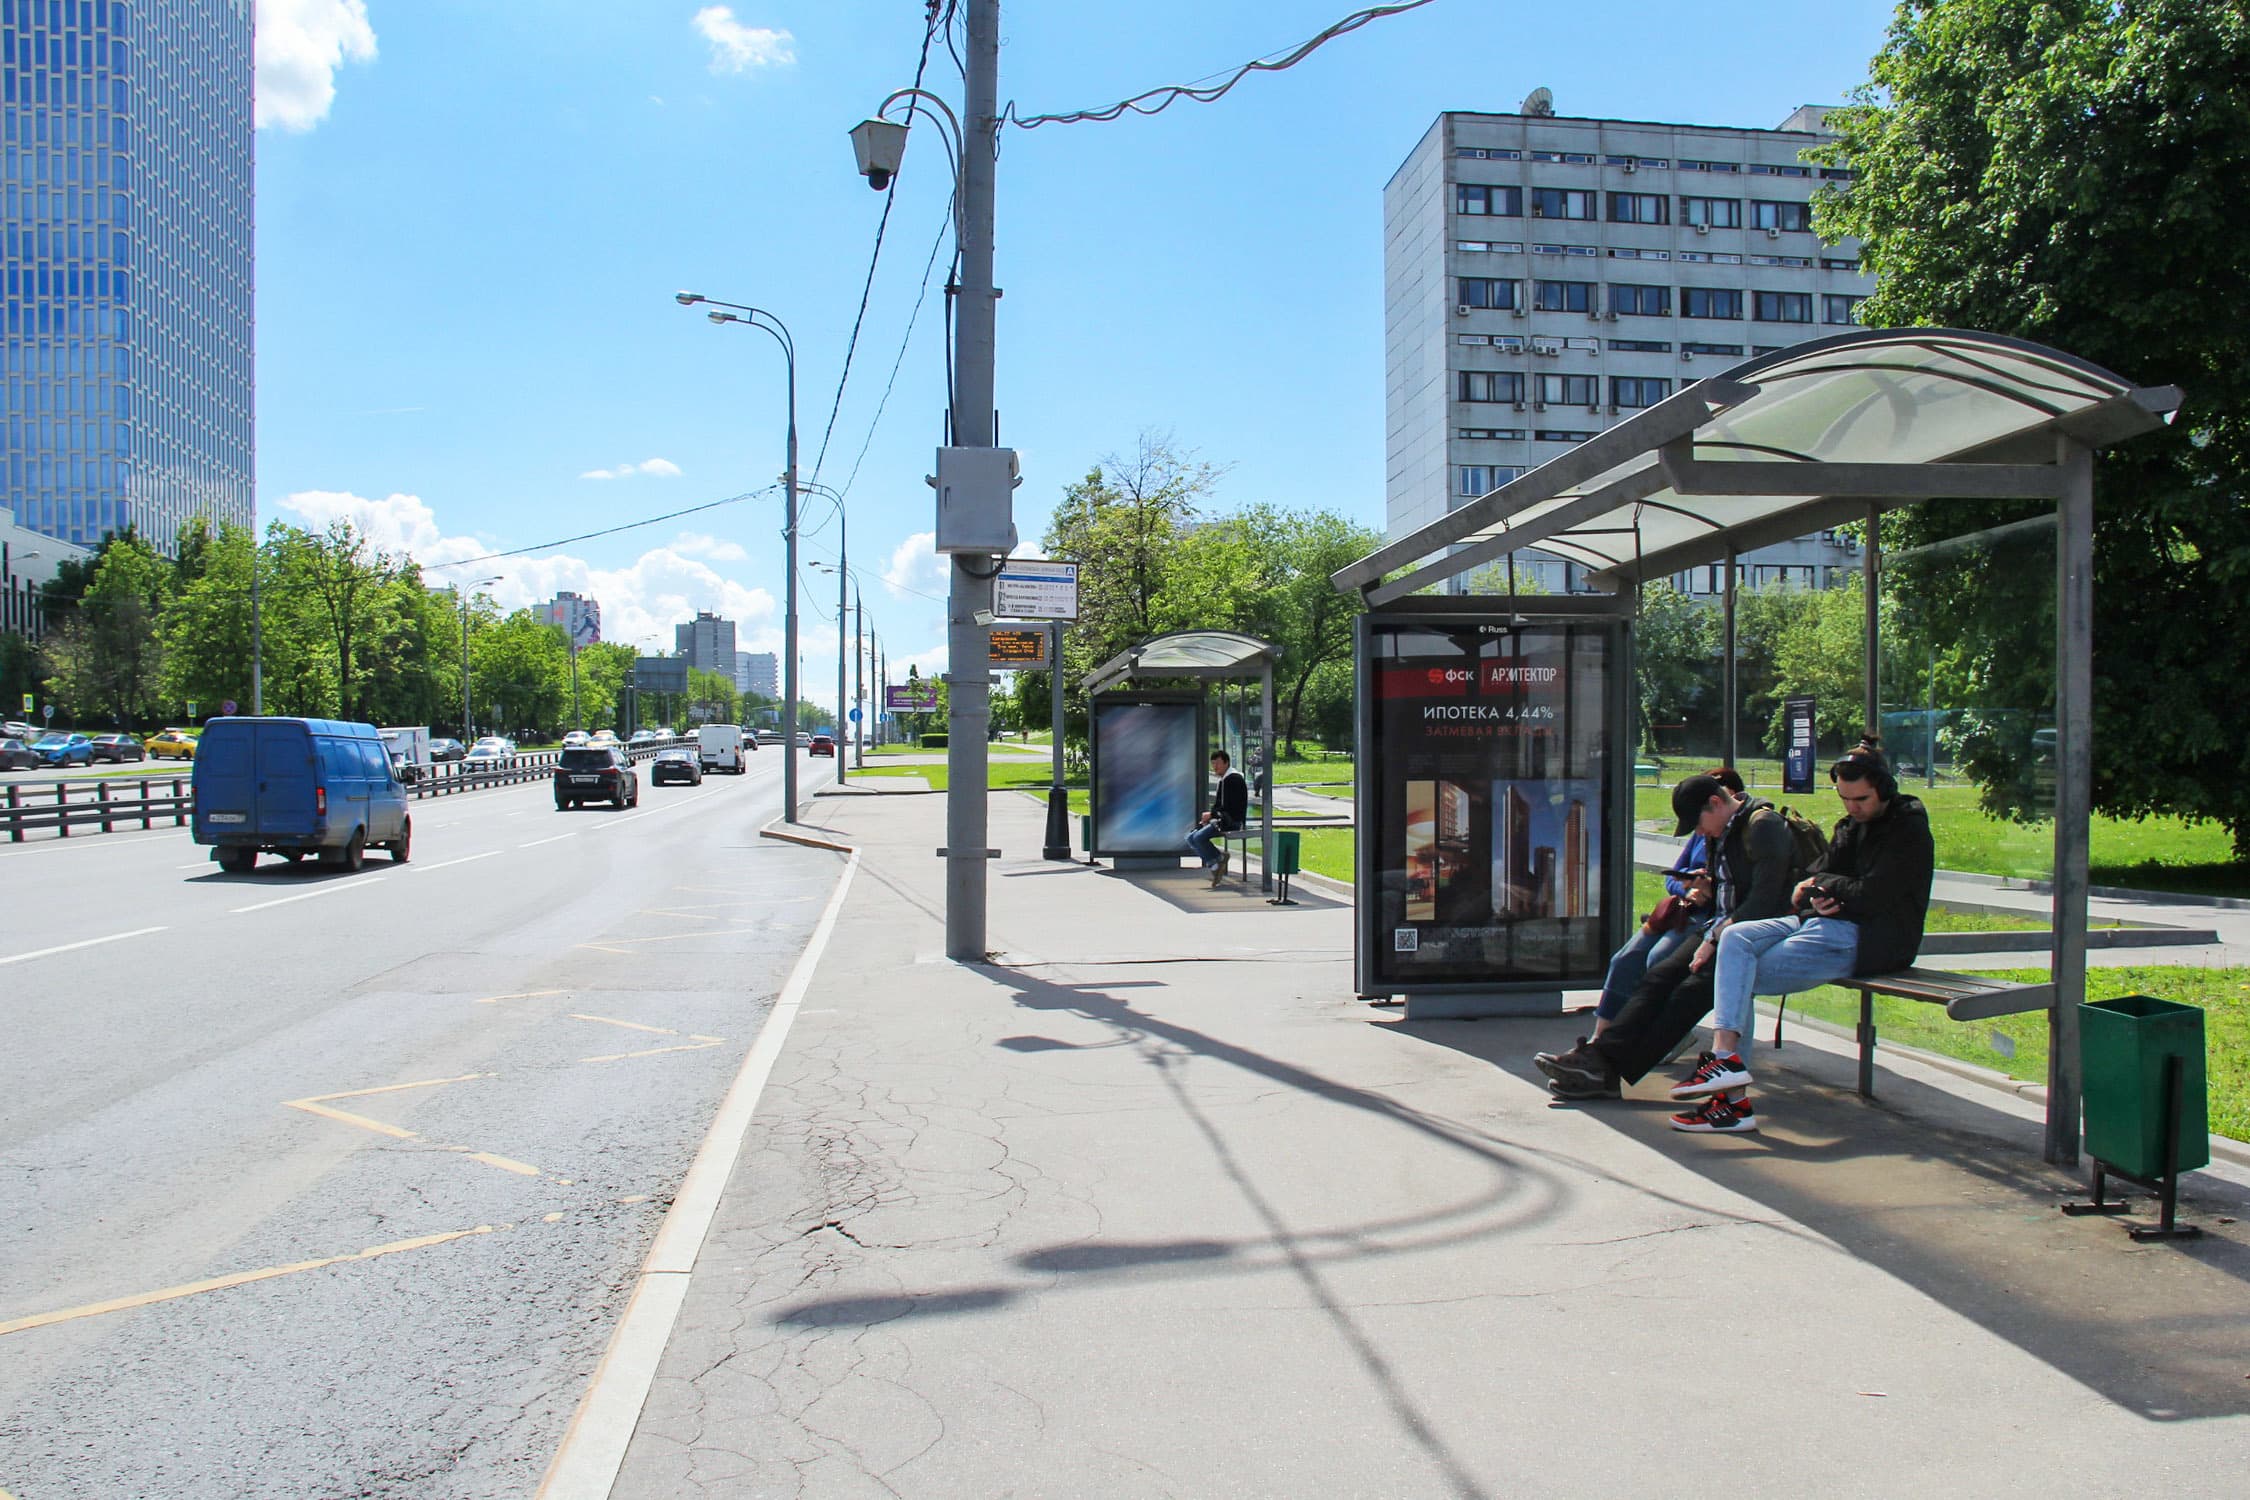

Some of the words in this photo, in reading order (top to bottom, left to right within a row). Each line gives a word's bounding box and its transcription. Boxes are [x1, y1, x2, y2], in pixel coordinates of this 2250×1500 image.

[1488, 625, 1508, 633] Russ
[1424, 706, 1500, 719] ИПОТЕКА
[1505, 706, 1554, 721] 4,44%
